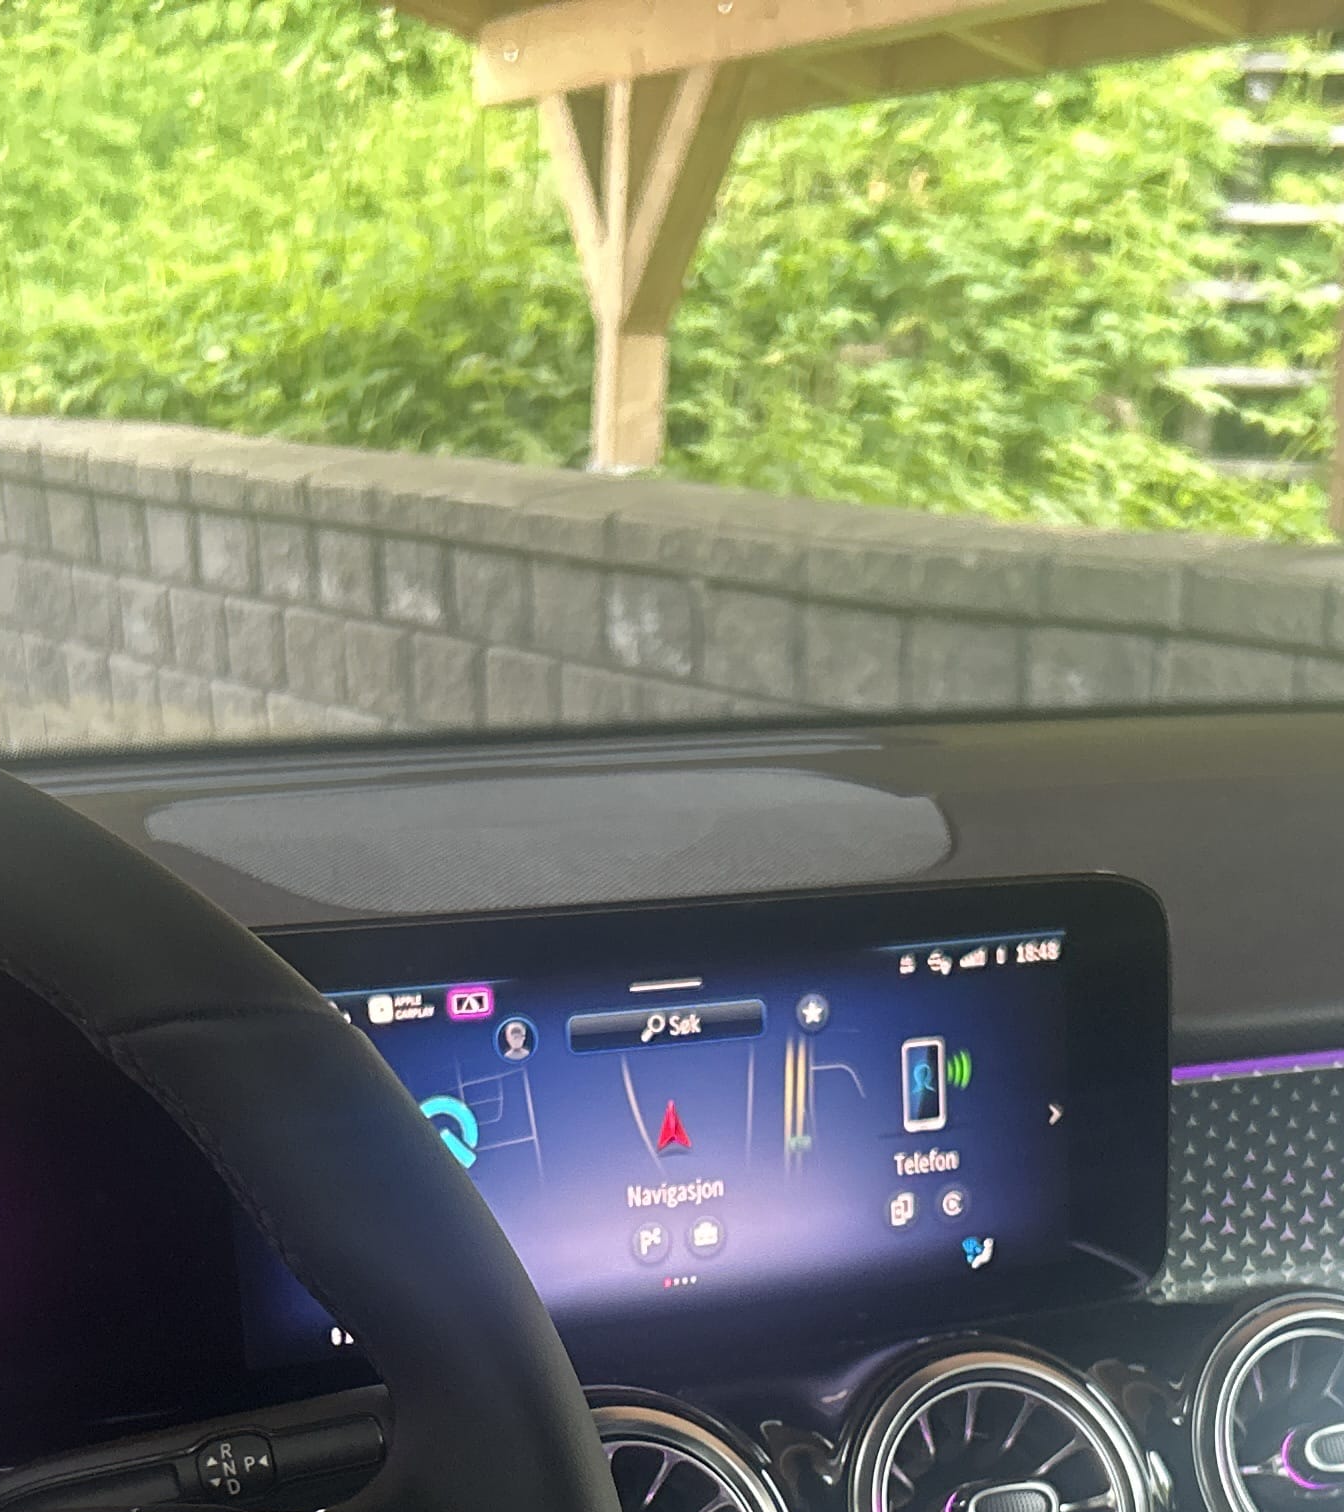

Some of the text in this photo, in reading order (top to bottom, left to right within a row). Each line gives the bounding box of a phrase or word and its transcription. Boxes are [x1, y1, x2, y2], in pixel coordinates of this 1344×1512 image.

[1016, 938, 1060, 963] 18:48
[669, 1014, 701, 1036] Søk
[894, 1147, 960, 1176] Telefon
[627, 1178, 724, 1208] Navigasjon
[220, 1443, 233, 1459] R
[222, 1460, 237, 1477] N
[244, 1455, 256, 1473] P
[227, 1479, 241, 1496] D
